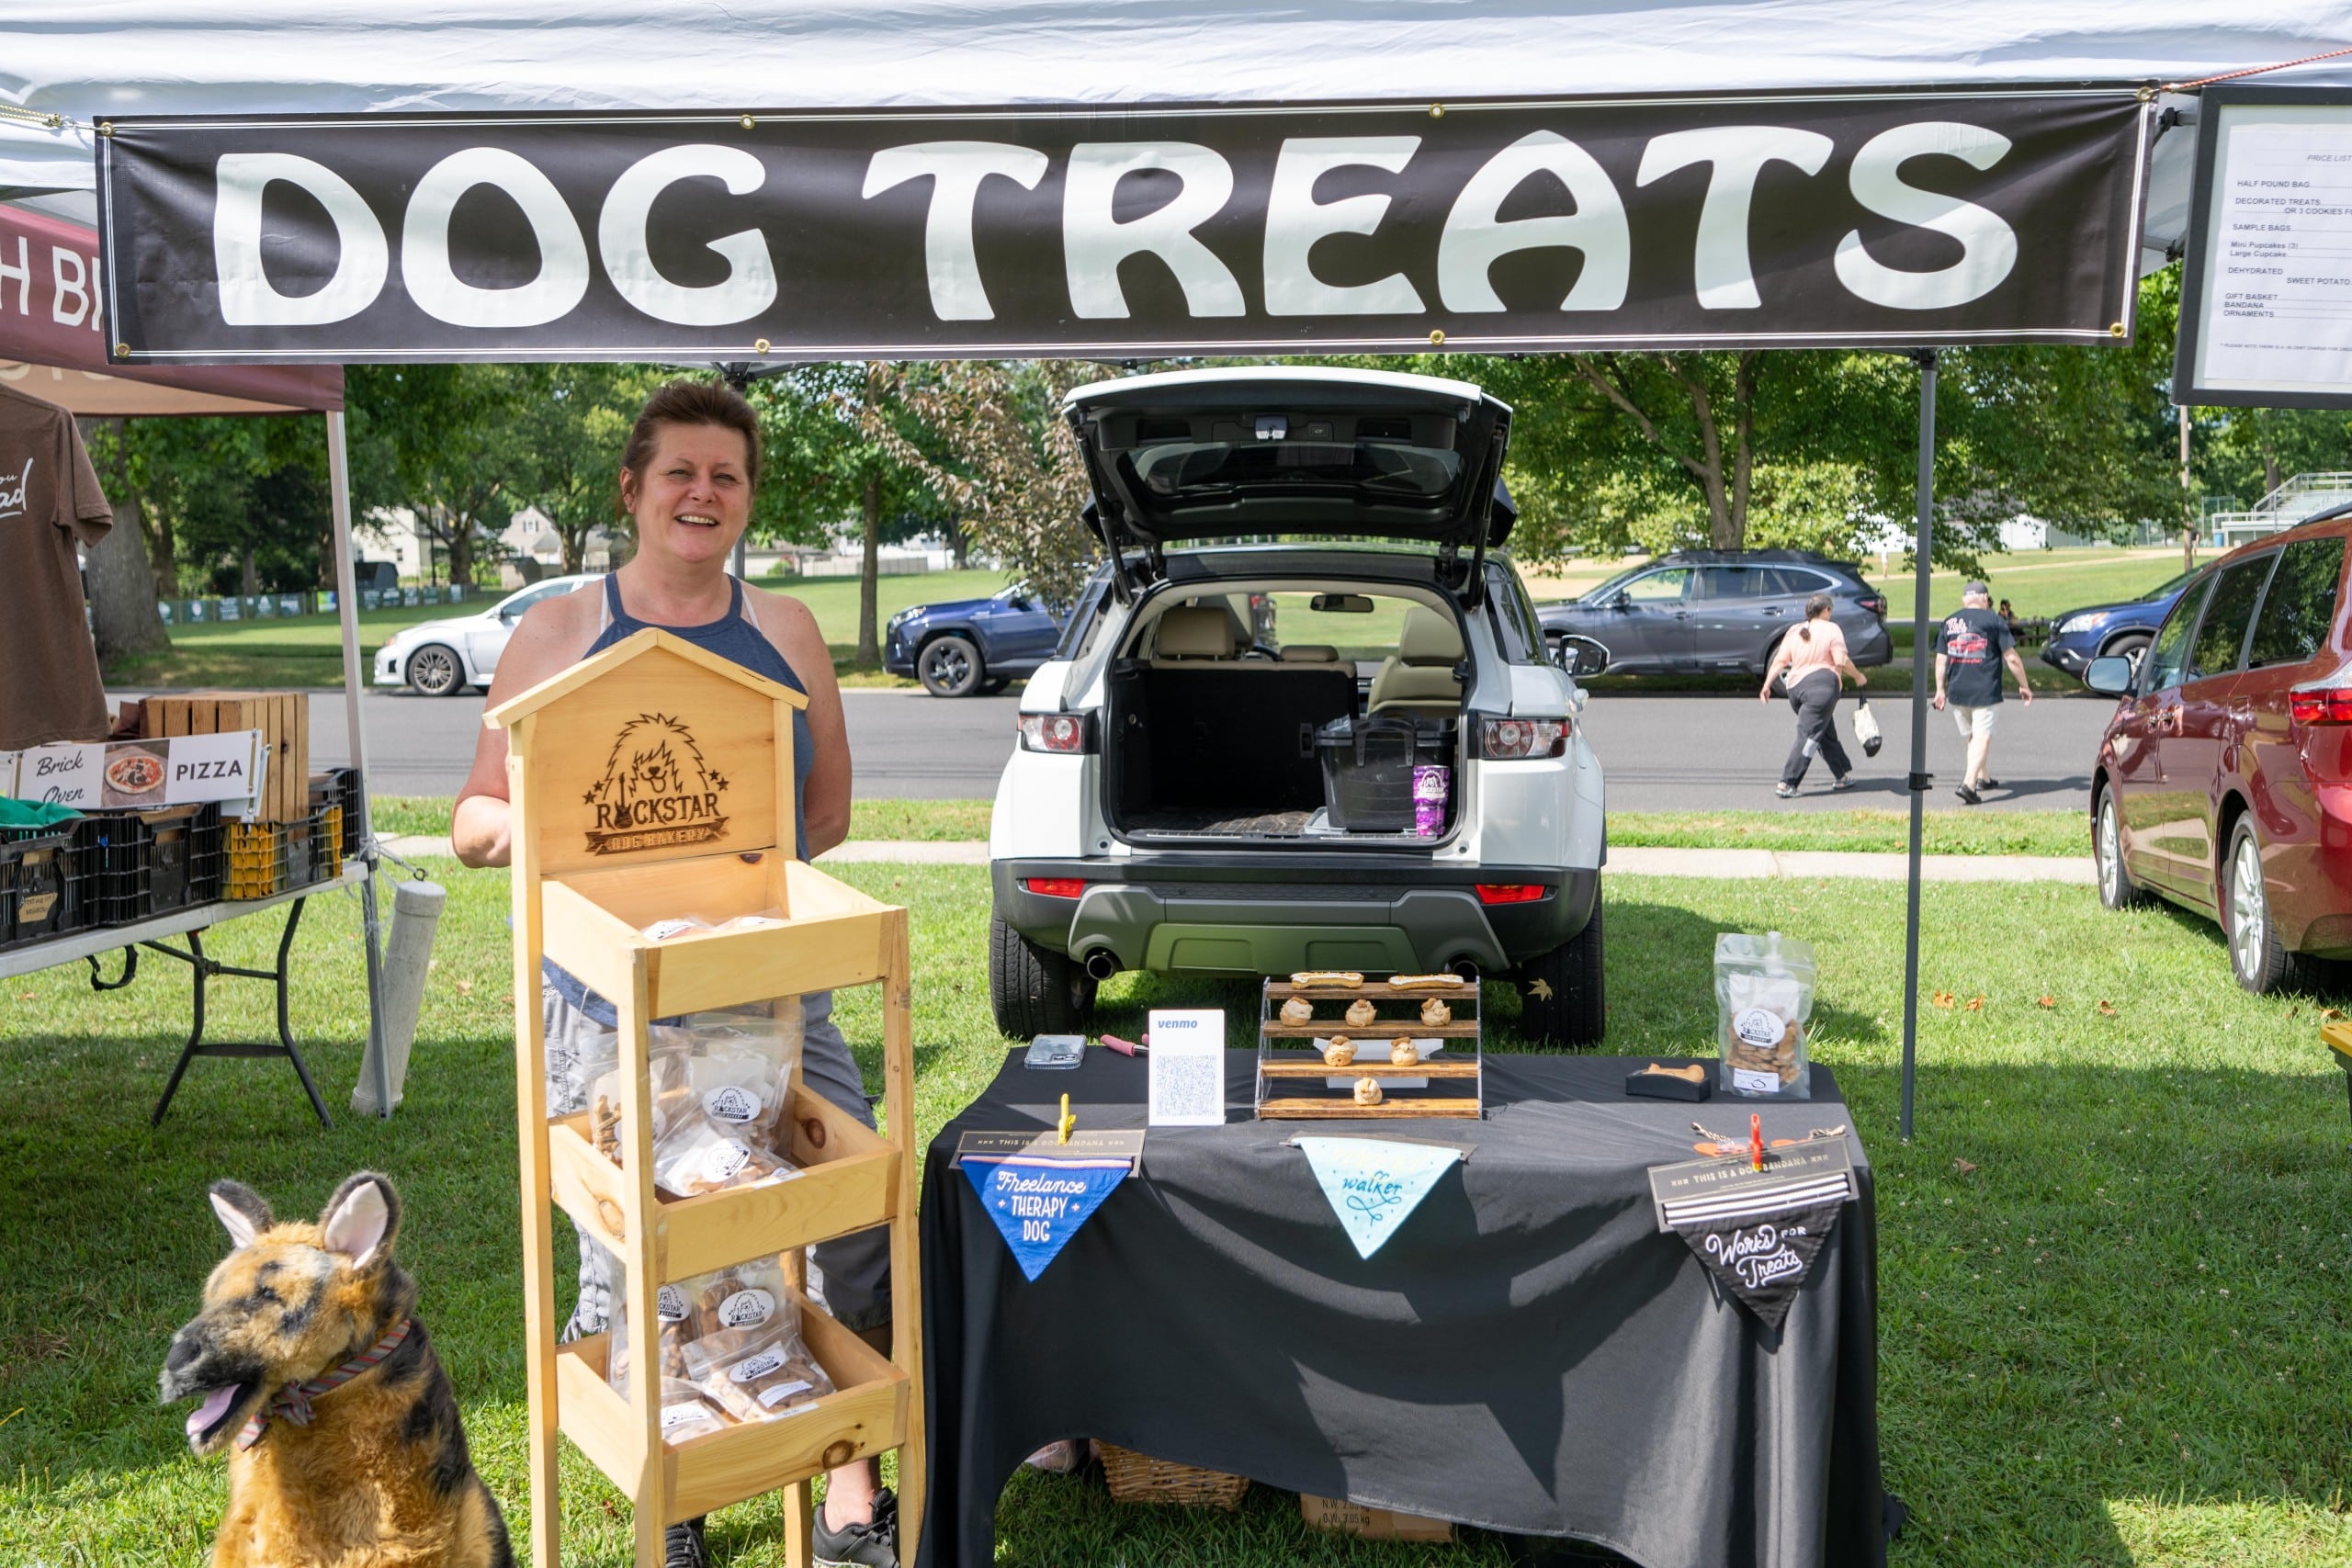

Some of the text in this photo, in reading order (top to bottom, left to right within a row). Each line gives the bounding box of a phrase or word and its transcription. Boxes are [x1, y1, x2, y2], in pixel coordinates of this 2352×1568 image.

[213, 121, 2018, 326] DOG TREATS
[2233, 223, 2266, 231] SAMPLE
[2229, 250, 2288, 259] Large Cupcake
[2248, 242, 2287, 250] Pupcakes
[2228, 266, 2283, 275] DEHYDRATED
[2286, 276, 2351, 286] SWEET POTATO
[2225, 292, 2278, 301] GIFT BASKET
[2222, 310, 2275, 318] ORNAMENTS
[36, 750, 84, 777] Brick
[175, 759, 243, 782] PIZZA
[42, 785, 85, 805] Oven
[594, 792, 721, 830] ROCKSTAR
[611, 827, 707, 851] DOG BAKERY
[1158, 1020, 1198, 1029] venmo
[1066, 1138, 1104, 1147] ANDANA
[1692, 1172, 1716, 1184] THIS
[1717, 1170, 1728, 1179] IS
[1729, 1168, 1738, 1178] A
[1762, 1157, 1807, 1172] BANDANA
[996, 1170, 1087, 1194] Freelance
[1342, 1171, 1402, 1202] walker
[1011, 1195, 1069, 1219] THERAPY
[1023, 1220, 1051, 1242] DOG
[1705, 1224, 1807, 1266] Works FOR
[1736, 1243, 1803, 1289] Treats
